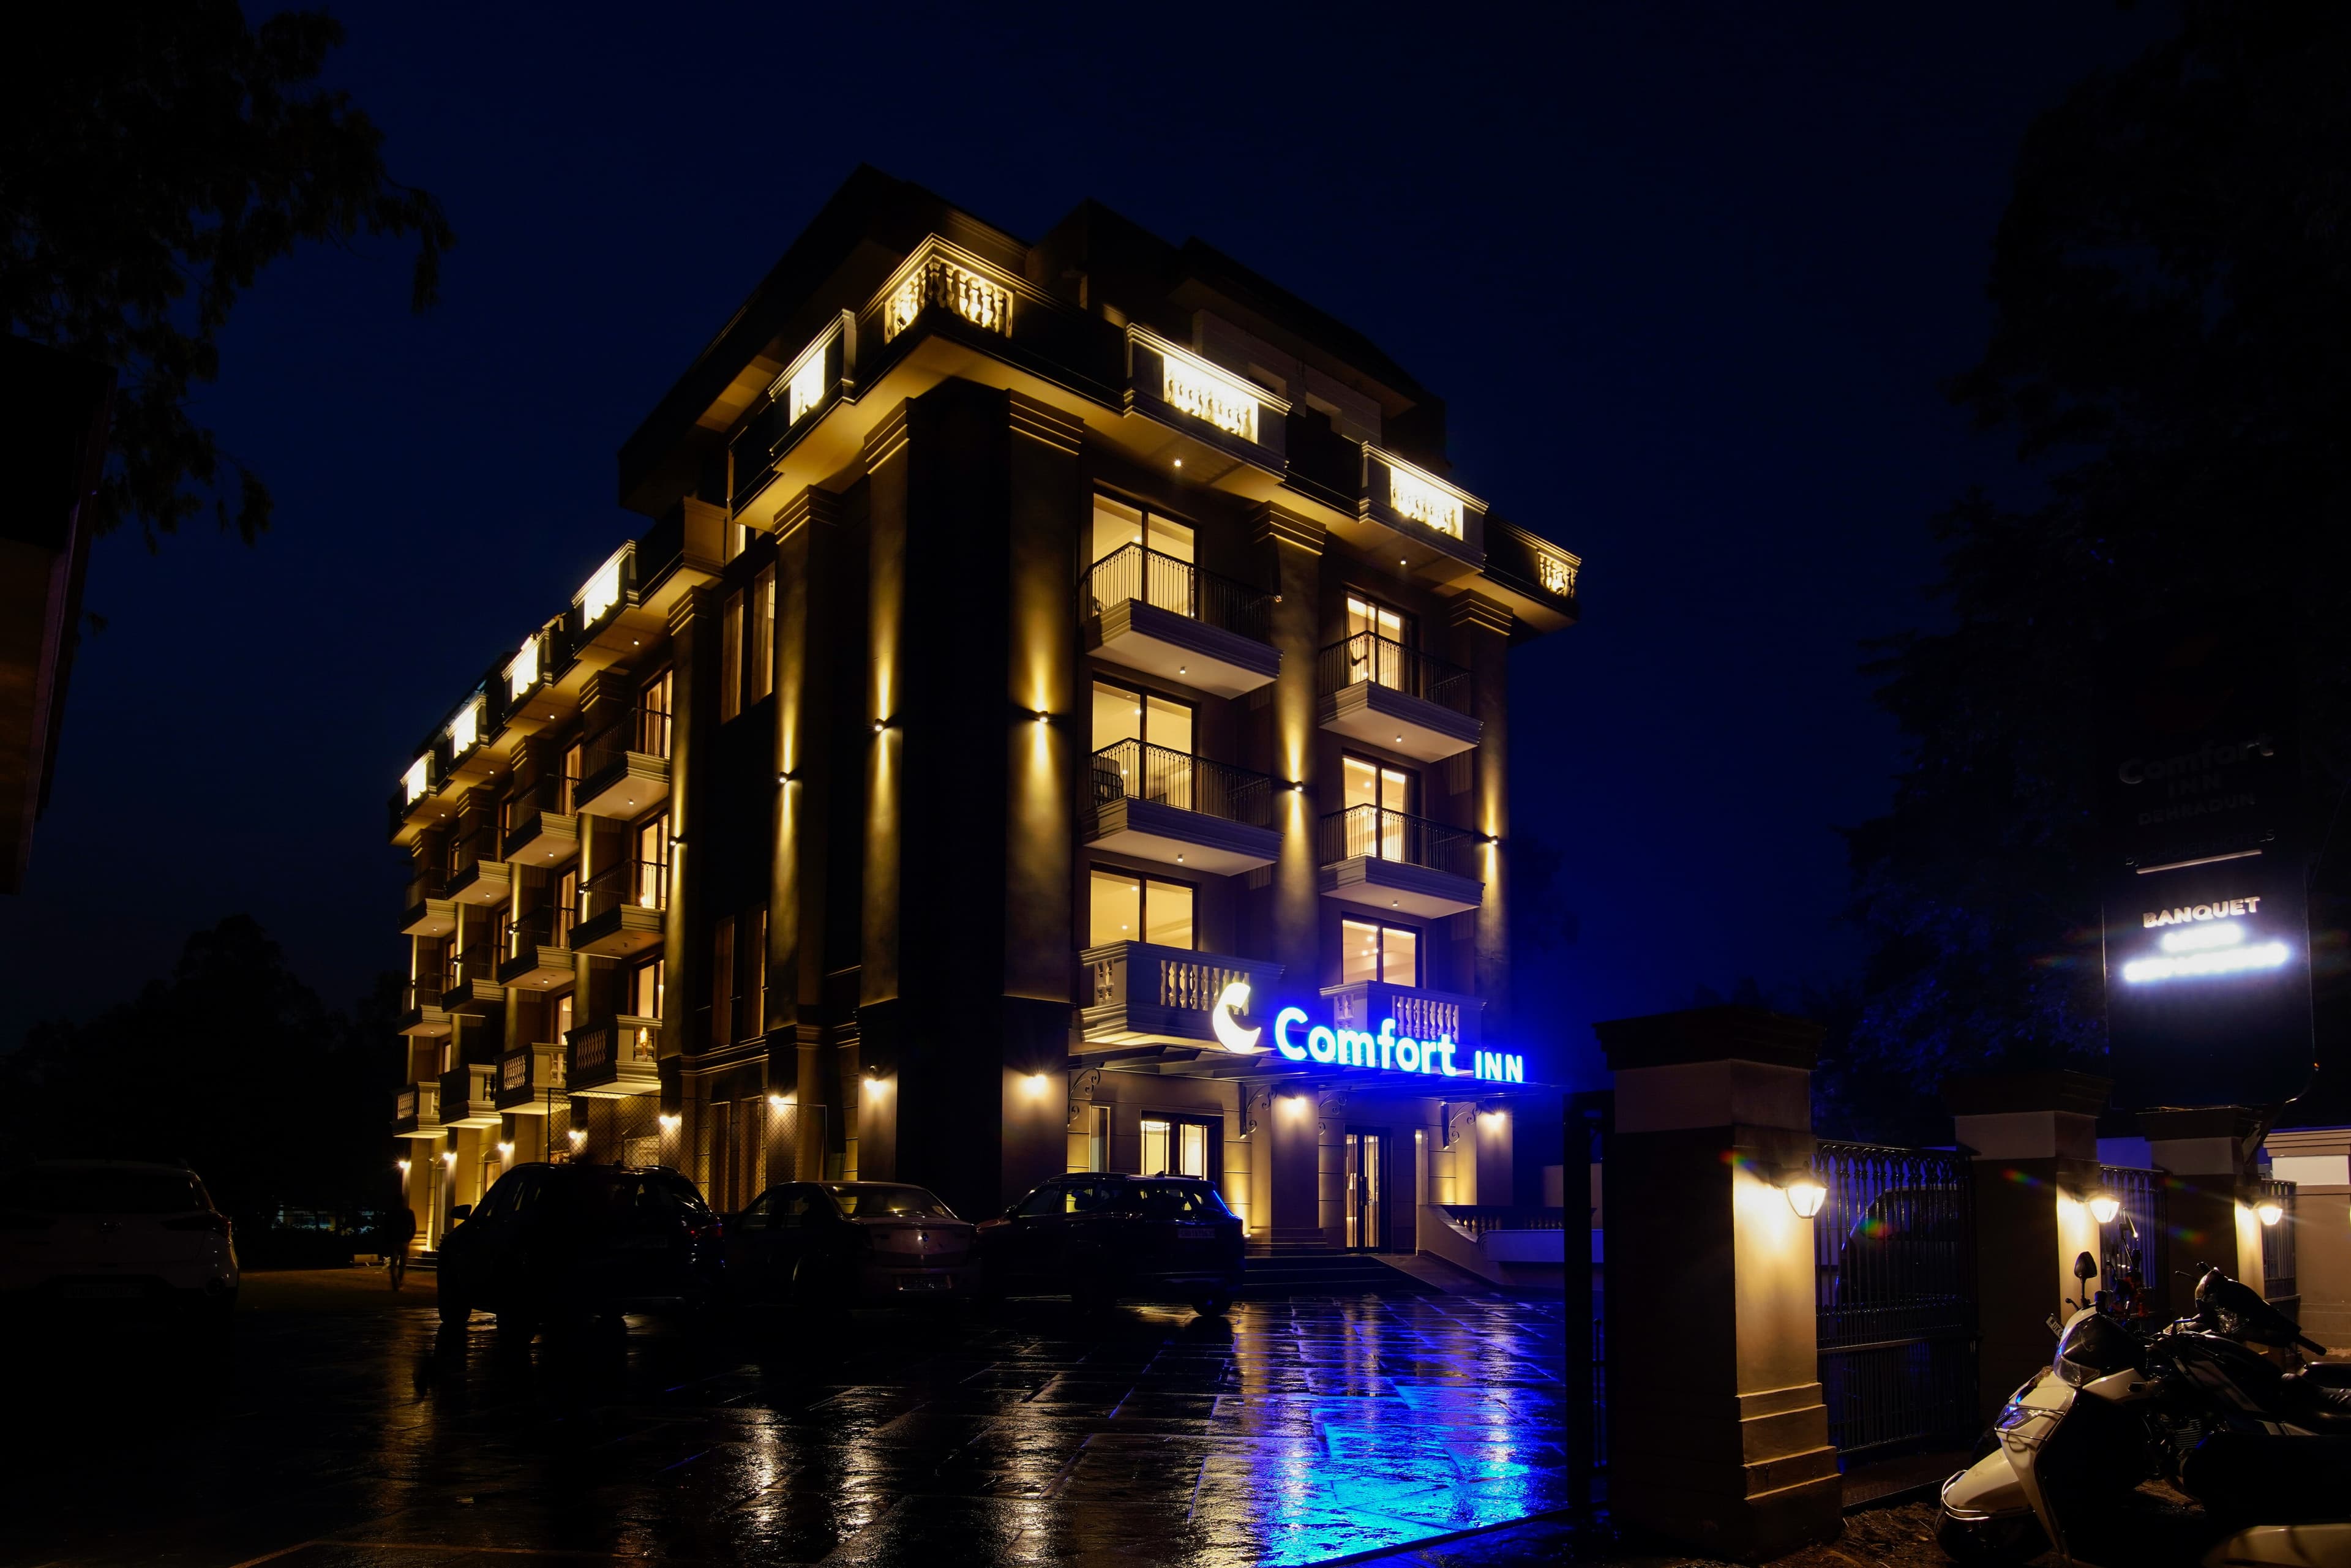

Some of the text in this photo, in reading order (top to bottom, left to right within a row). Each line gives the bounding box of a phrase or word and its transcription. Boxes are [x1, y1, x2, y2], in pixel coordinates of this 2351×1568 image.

[2118, 732, 2274, 784] Comfort
[2143, 896, 2260, 928] BANQUET
[1275, 1007, 1524, 1083] Comfort INN
